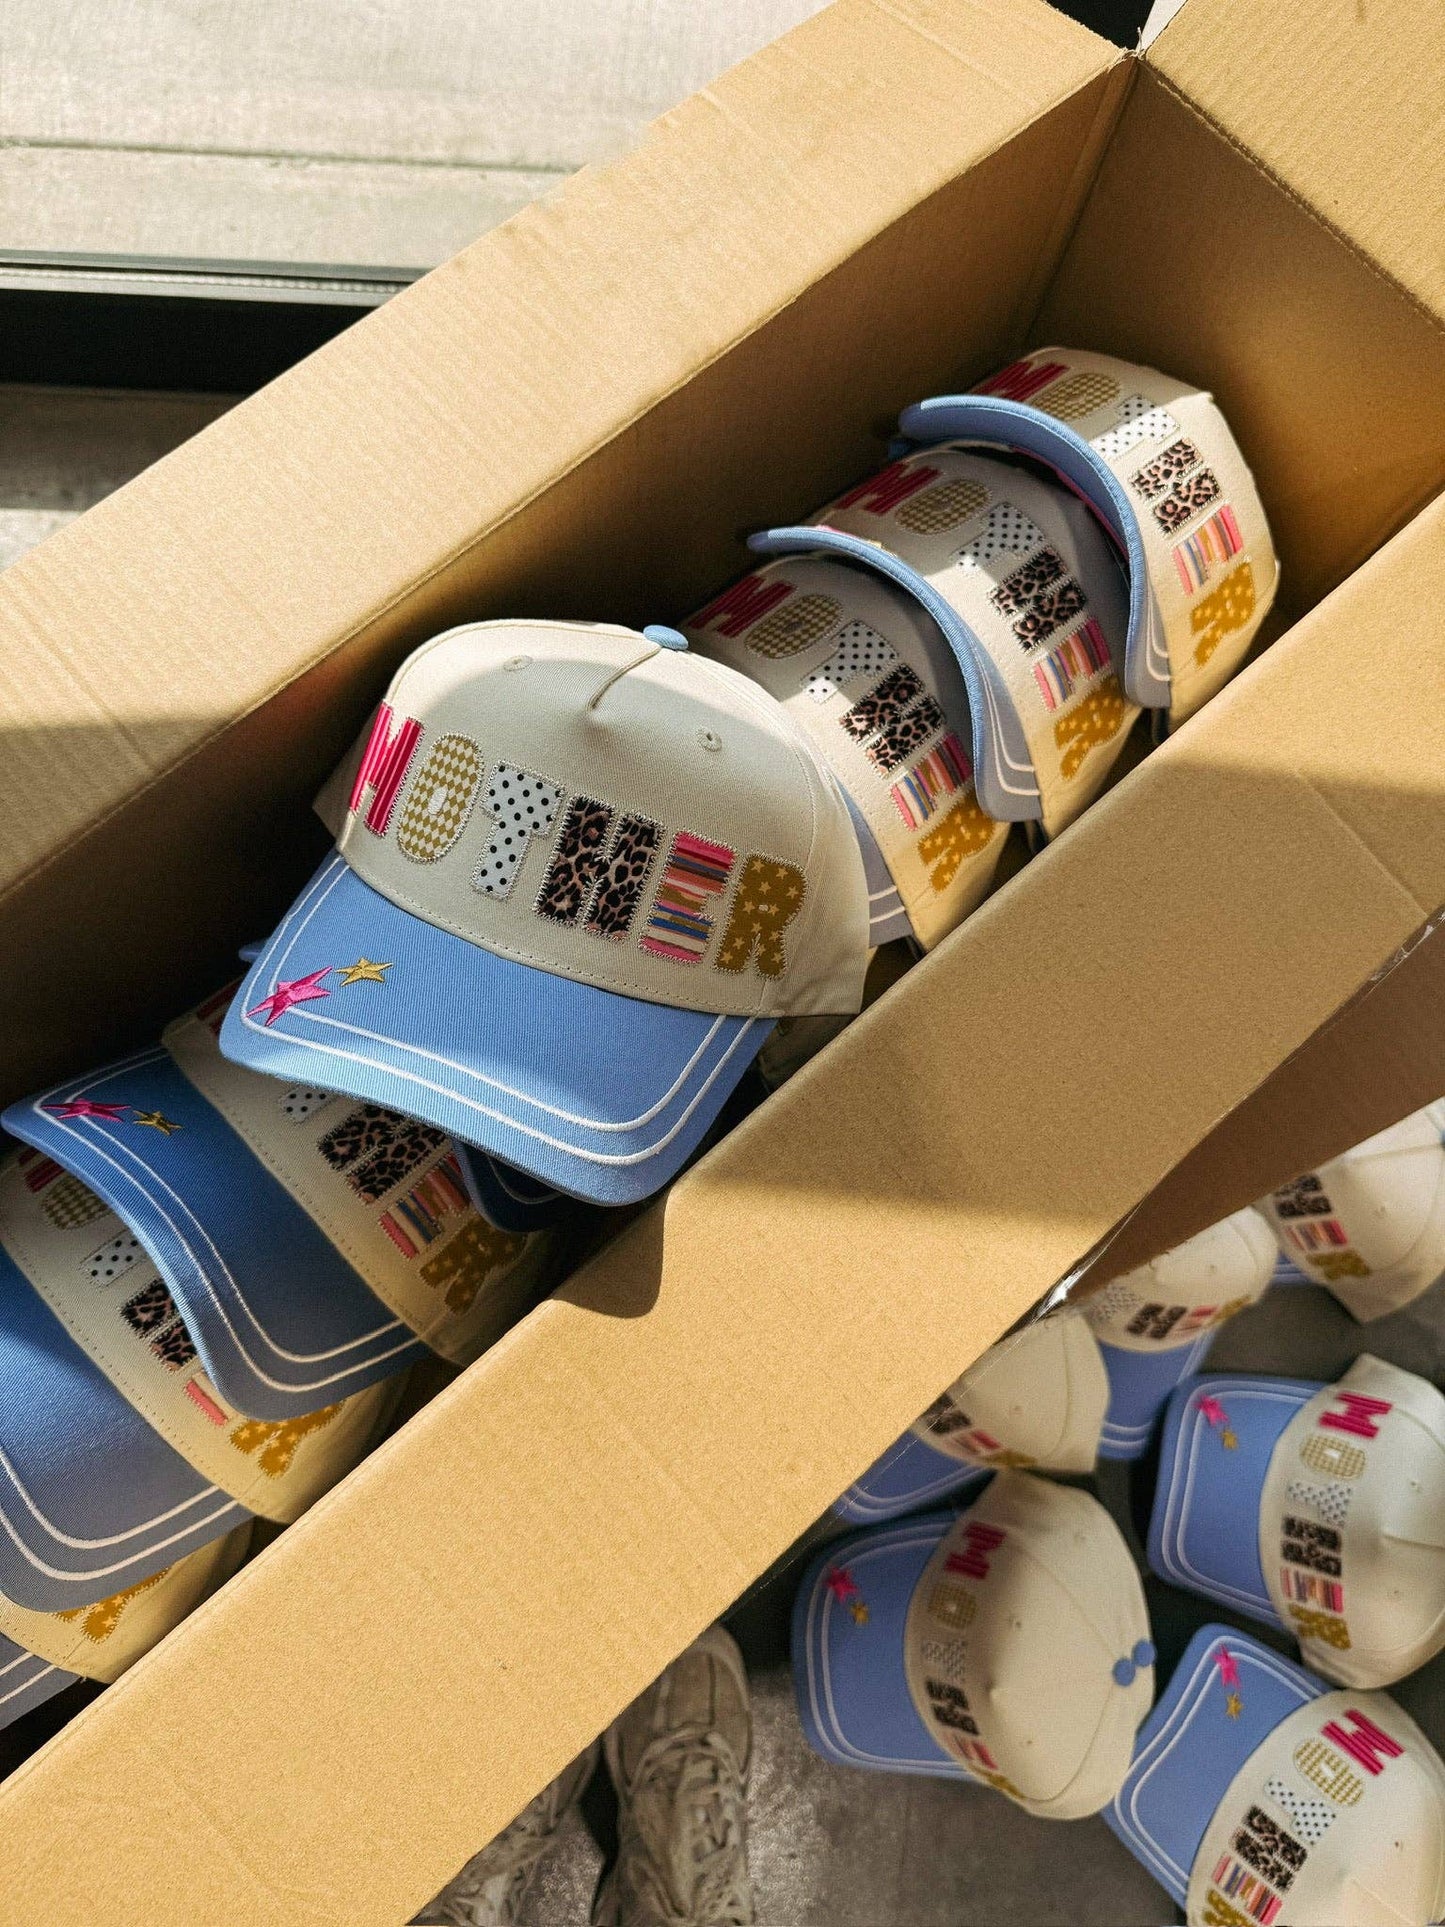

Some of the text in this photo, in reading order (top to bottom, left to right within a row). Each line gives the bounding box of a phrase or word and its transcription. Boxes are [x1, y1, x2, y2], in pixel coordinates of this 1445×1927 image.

[686, 574, 996, 892] MOTHER
[832, 461, 1126, 780] MOTHER
[350, 701, 807, 981] MOTHER
[1280, 1391, 1393, 1651] MOTHER
